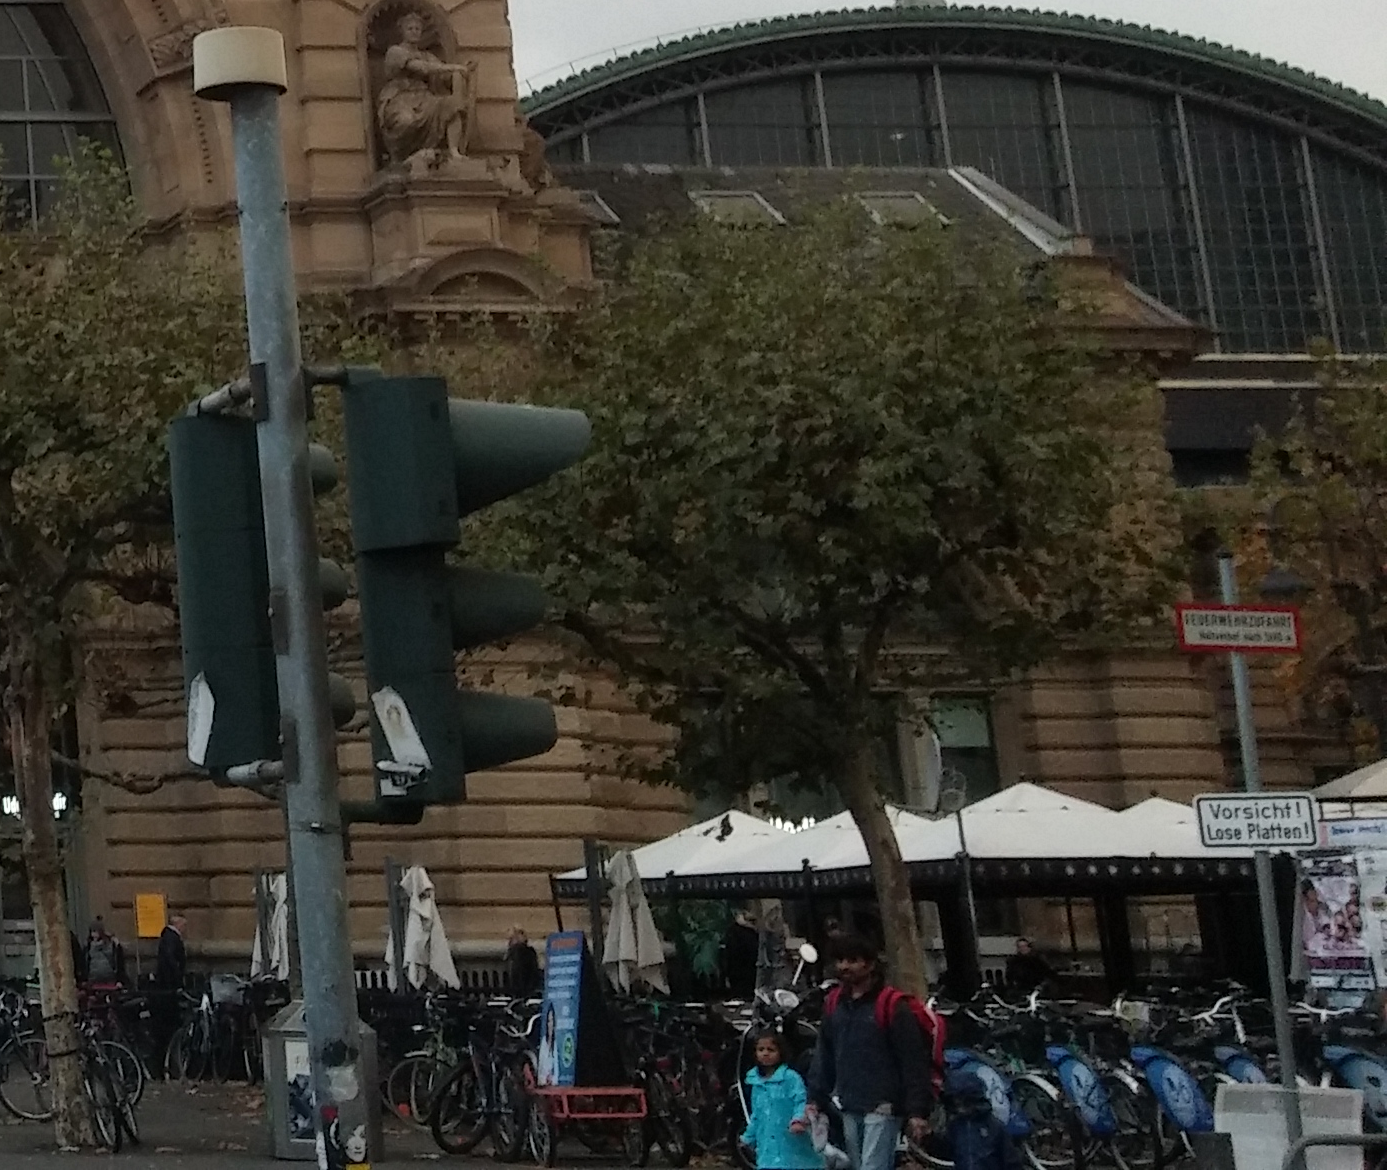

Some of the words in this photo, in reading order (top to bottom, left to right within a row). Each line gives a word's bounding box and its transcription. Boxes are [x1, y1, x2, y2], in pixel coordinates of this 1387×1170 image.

[1208, 801, 1301, 820] Vorsicht!
[1207, 824, 1242, 841] Lose
[1247, 822, 1309, 840] Platten!
